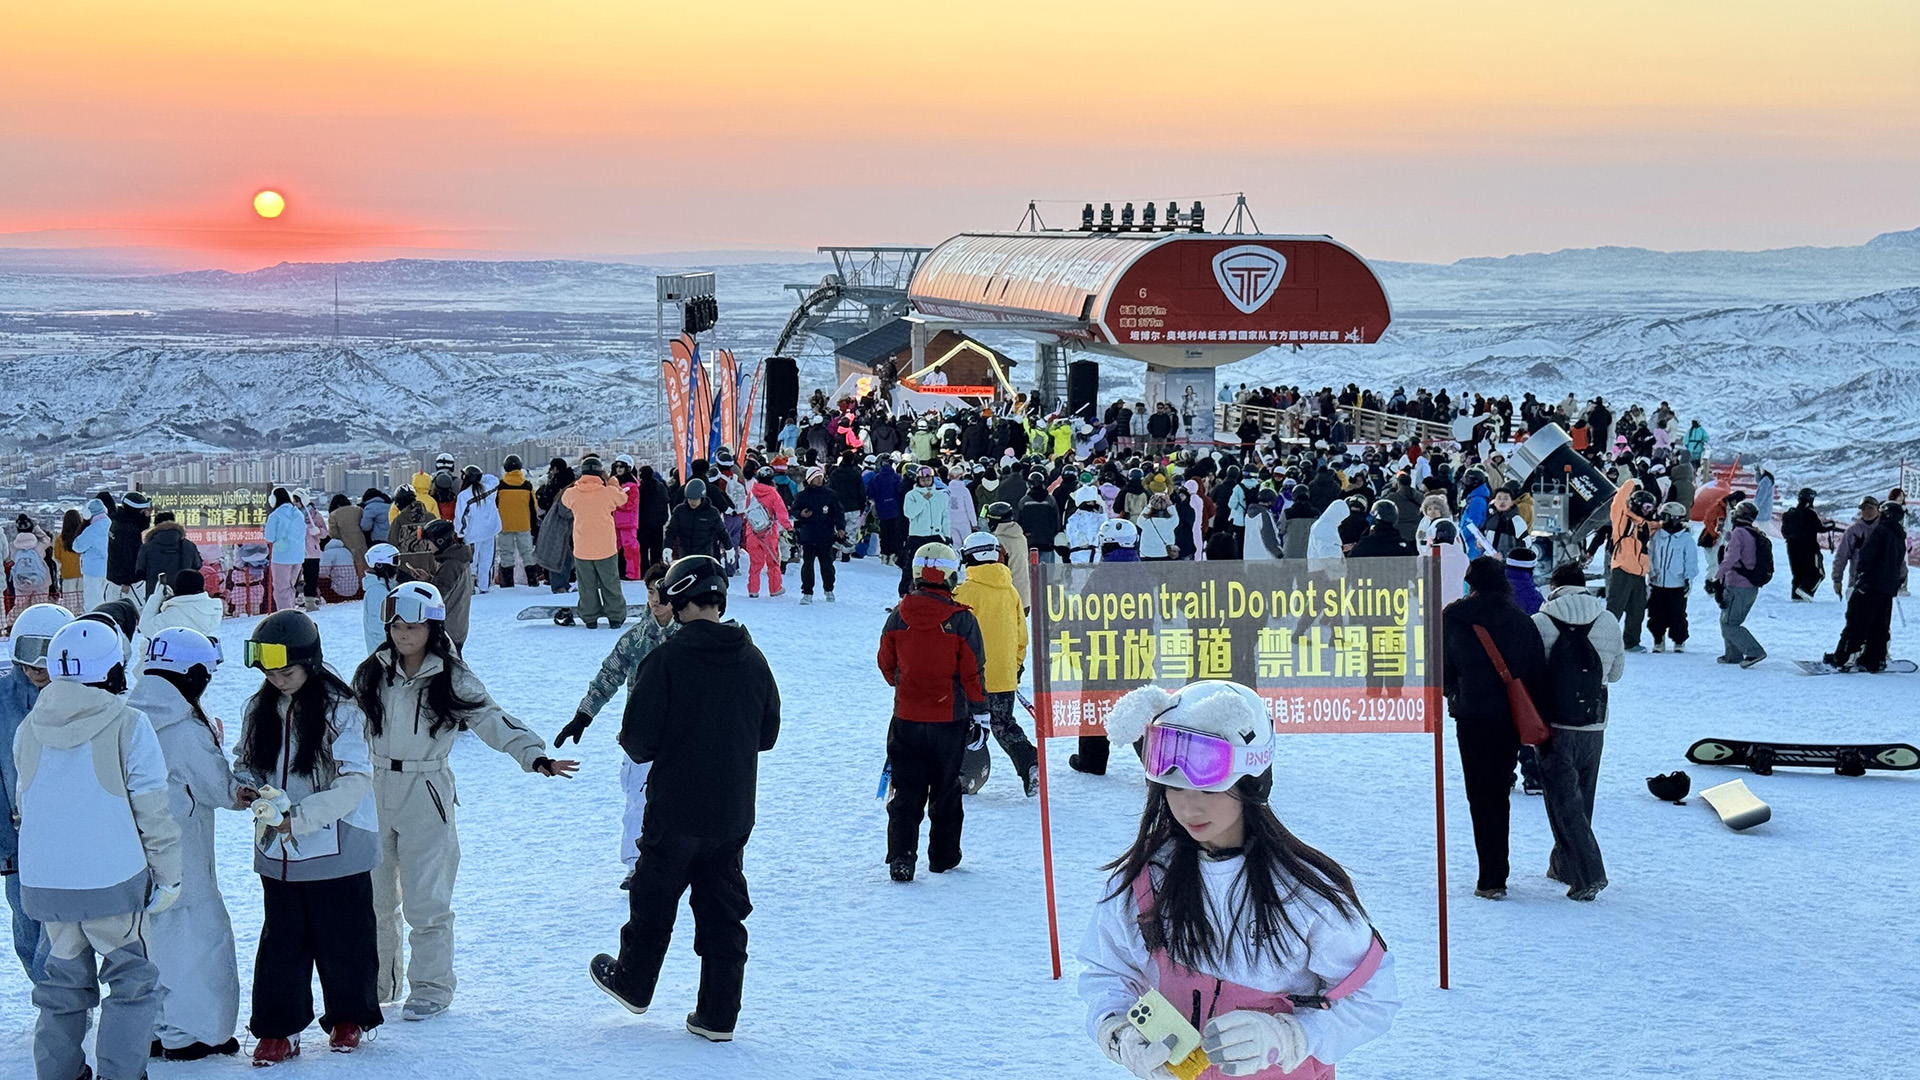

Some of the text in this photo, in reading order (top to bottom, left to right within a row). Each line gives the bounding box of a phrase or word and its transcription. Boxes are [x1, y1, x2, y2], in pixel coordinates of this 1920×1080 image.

[1139, 288, 1147, 298] 6
[180, 493, 223, 508] passageway
[223, 491, 251, 505] Visitors
[252, 491, 267, 506] stop
[207, 508, 267, 526] 游客止步
[1047, 584, 1153, 630] Unopen
[1272, 580, 1317, 617] not
[1049, 628, 1233, 682] 未开放雪道
